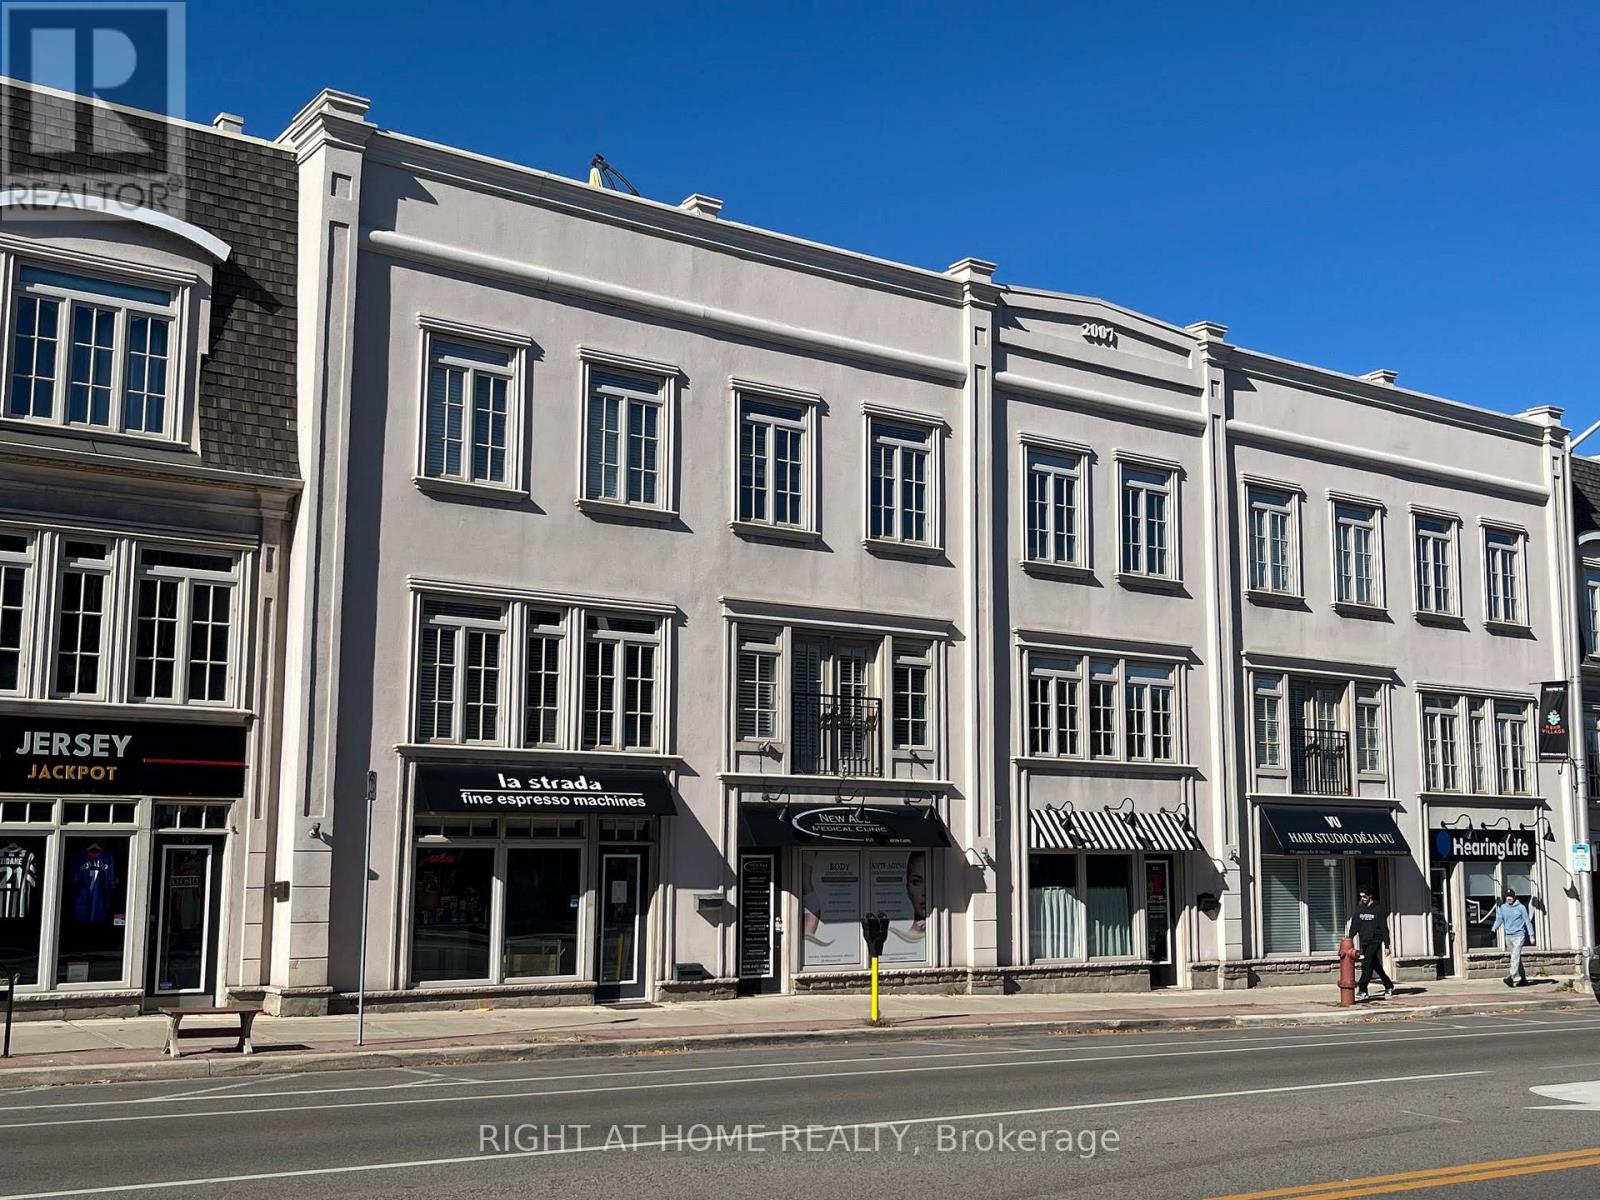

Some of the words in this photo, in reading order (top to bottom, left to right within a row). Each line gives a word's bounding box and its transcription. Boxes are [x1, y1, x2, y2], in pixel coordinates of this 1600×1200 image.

[1081, 322, 1114, 342] 2007
[15, 731, 133, 758] JERSEY
[27, 763, 118, 781] JACKPOT
[497, 772, 521, 788] la
[528, 775, 602, 790] strada
[461, 791, 493, 805] fine
[497, 794, 570, 807] espresso
[574, 794, 646, 807] machines
[1287, 832, 1316, 843] HAIR
[1314, 832, 1353, 844] STUDIO
[1379, 833, 1395, 844] VU
[1453, 834, 1529, 860] HearingLife
[829, 863, 849, 871] BODY
[0, 866, 23, 889] 21
